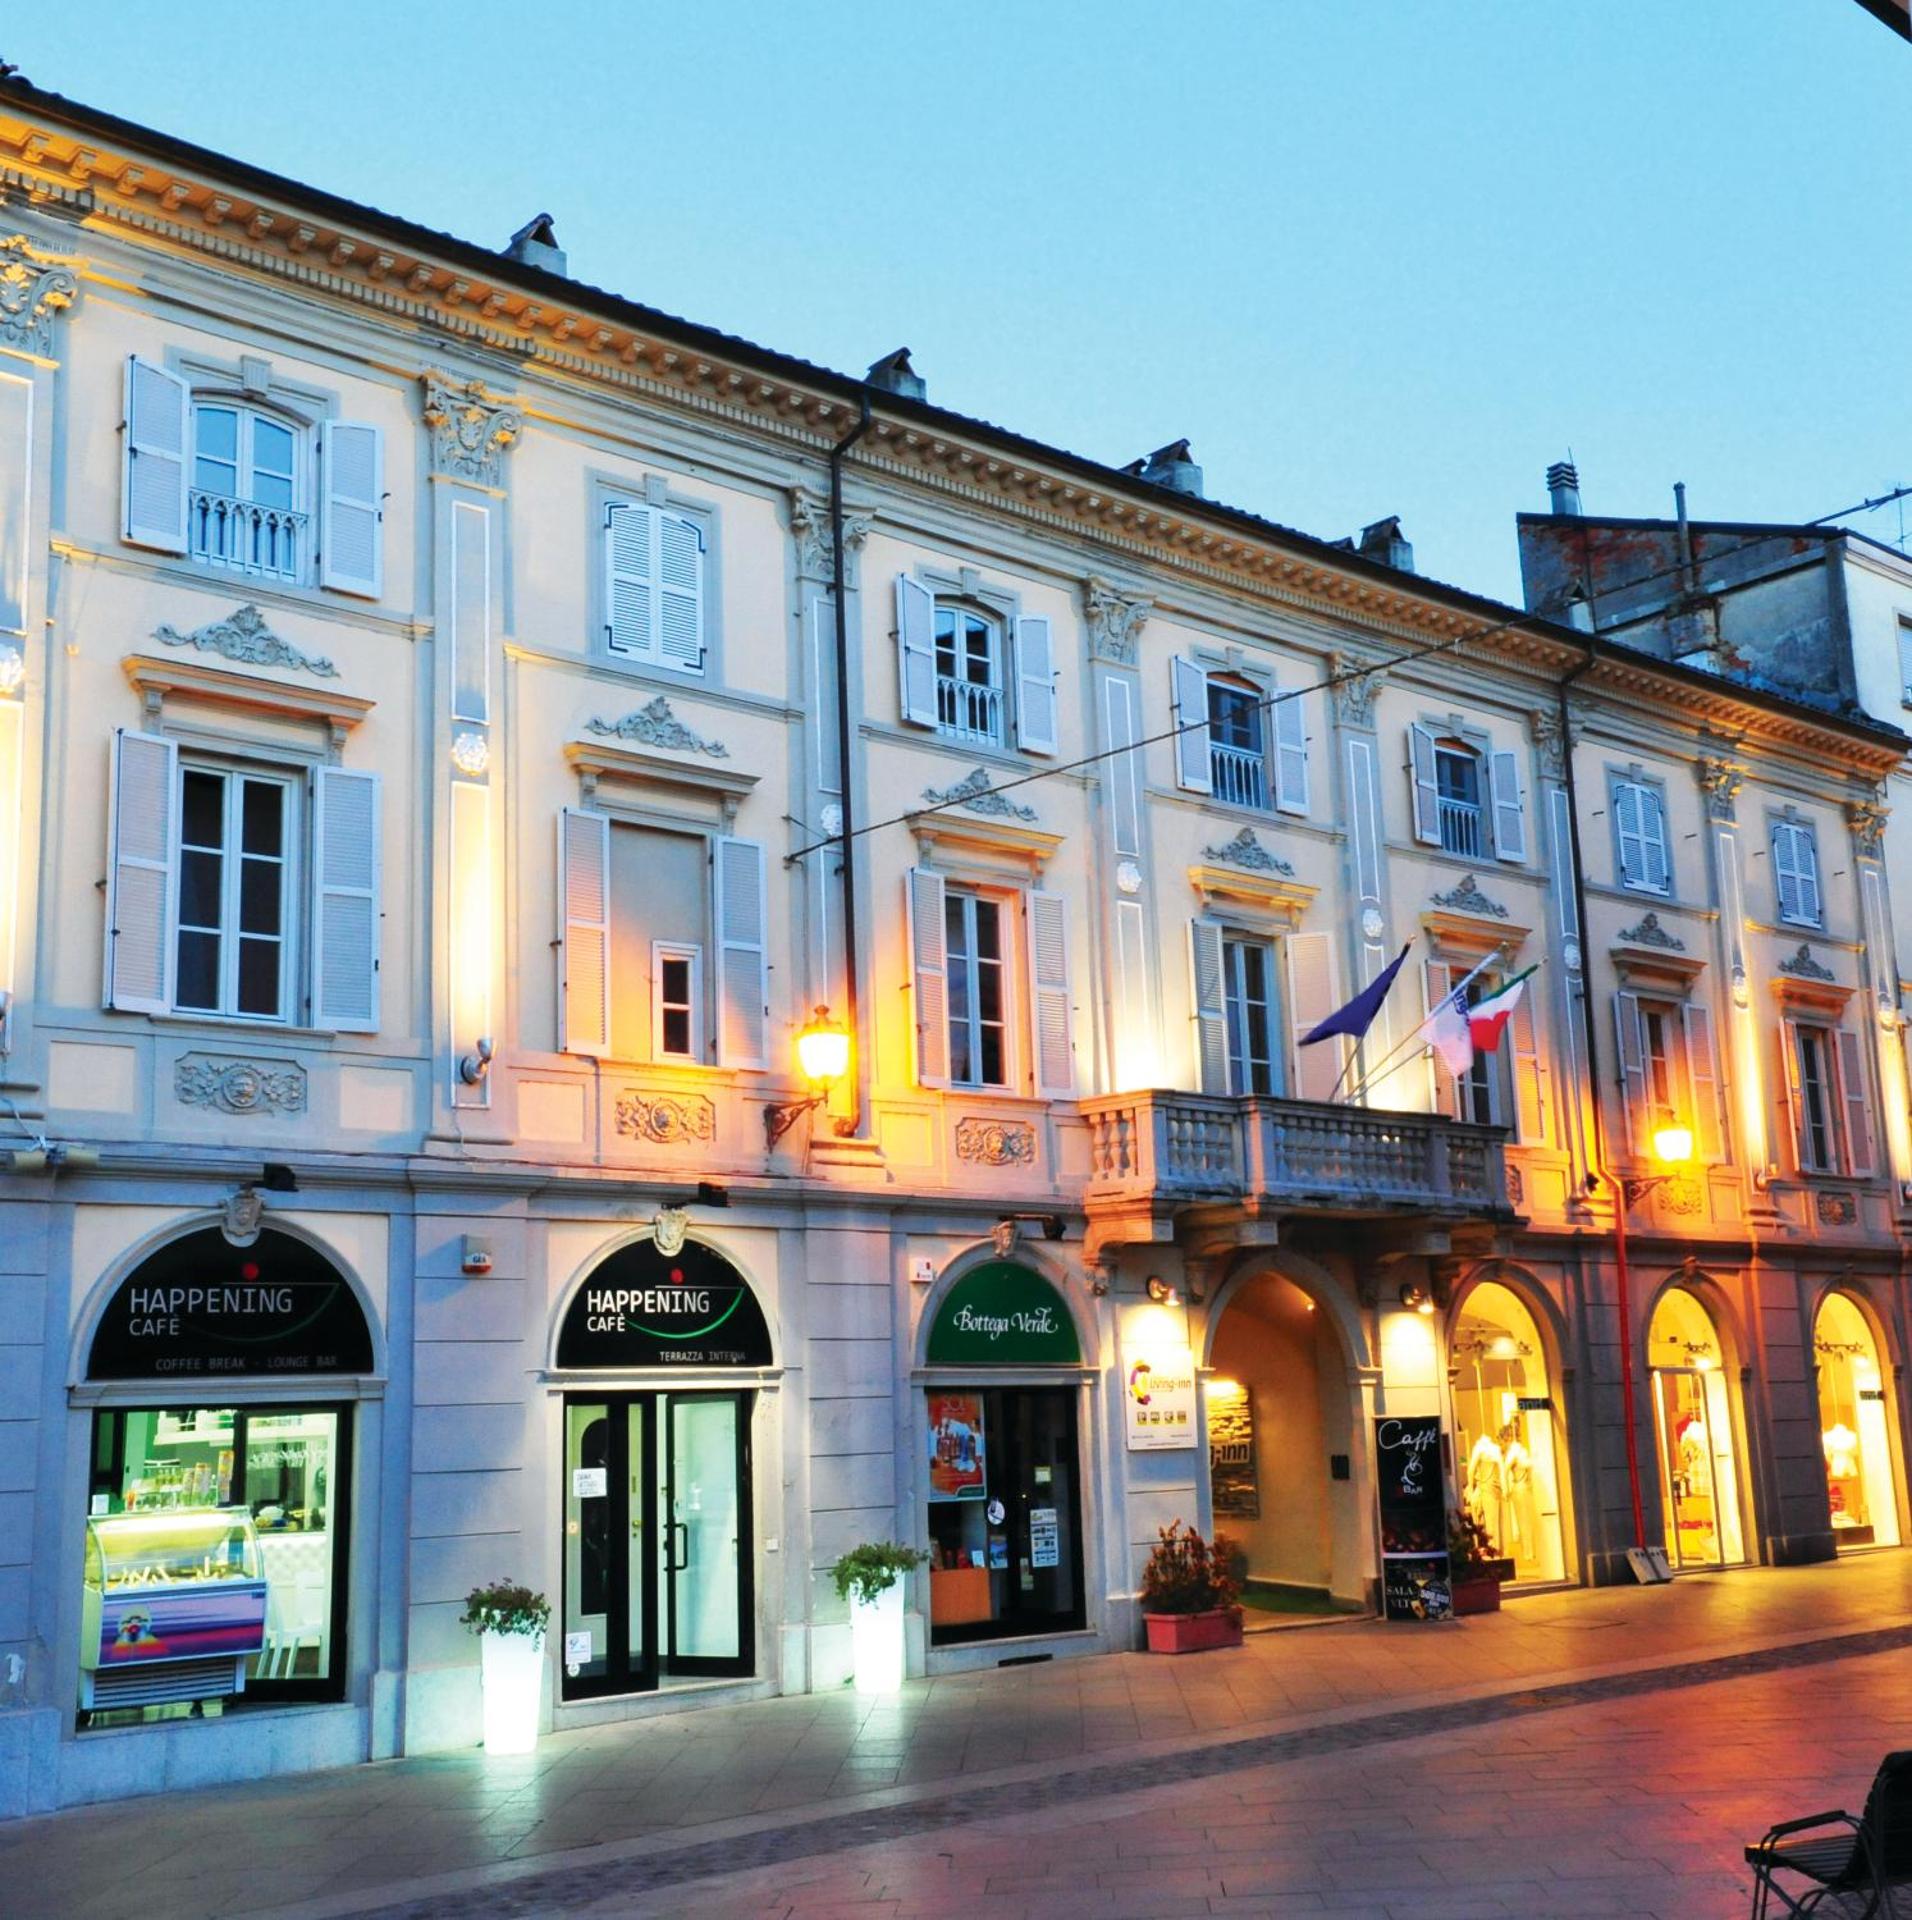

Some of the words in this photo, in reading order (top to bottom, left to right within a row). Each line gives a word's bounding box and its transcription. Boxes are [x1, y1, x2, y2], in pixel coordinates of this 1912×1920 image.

[130, 1288, 293, 1314] HAPPENING
[587, 1290, 710, 1313] HAPPENING
[953, 1304, 1009, 1341] Bottega
[1010, 1307, 1059, 1334] Verde
[154, 1358, 201, 1371] COFFEE
[208, 1357, 246, 1370] BREAK
[267, 1356, 309, 1369] LOUNGE
[316, 1355, 337, 1368] BAR
[660, 1351, 704, 1362] TERRAZZA
